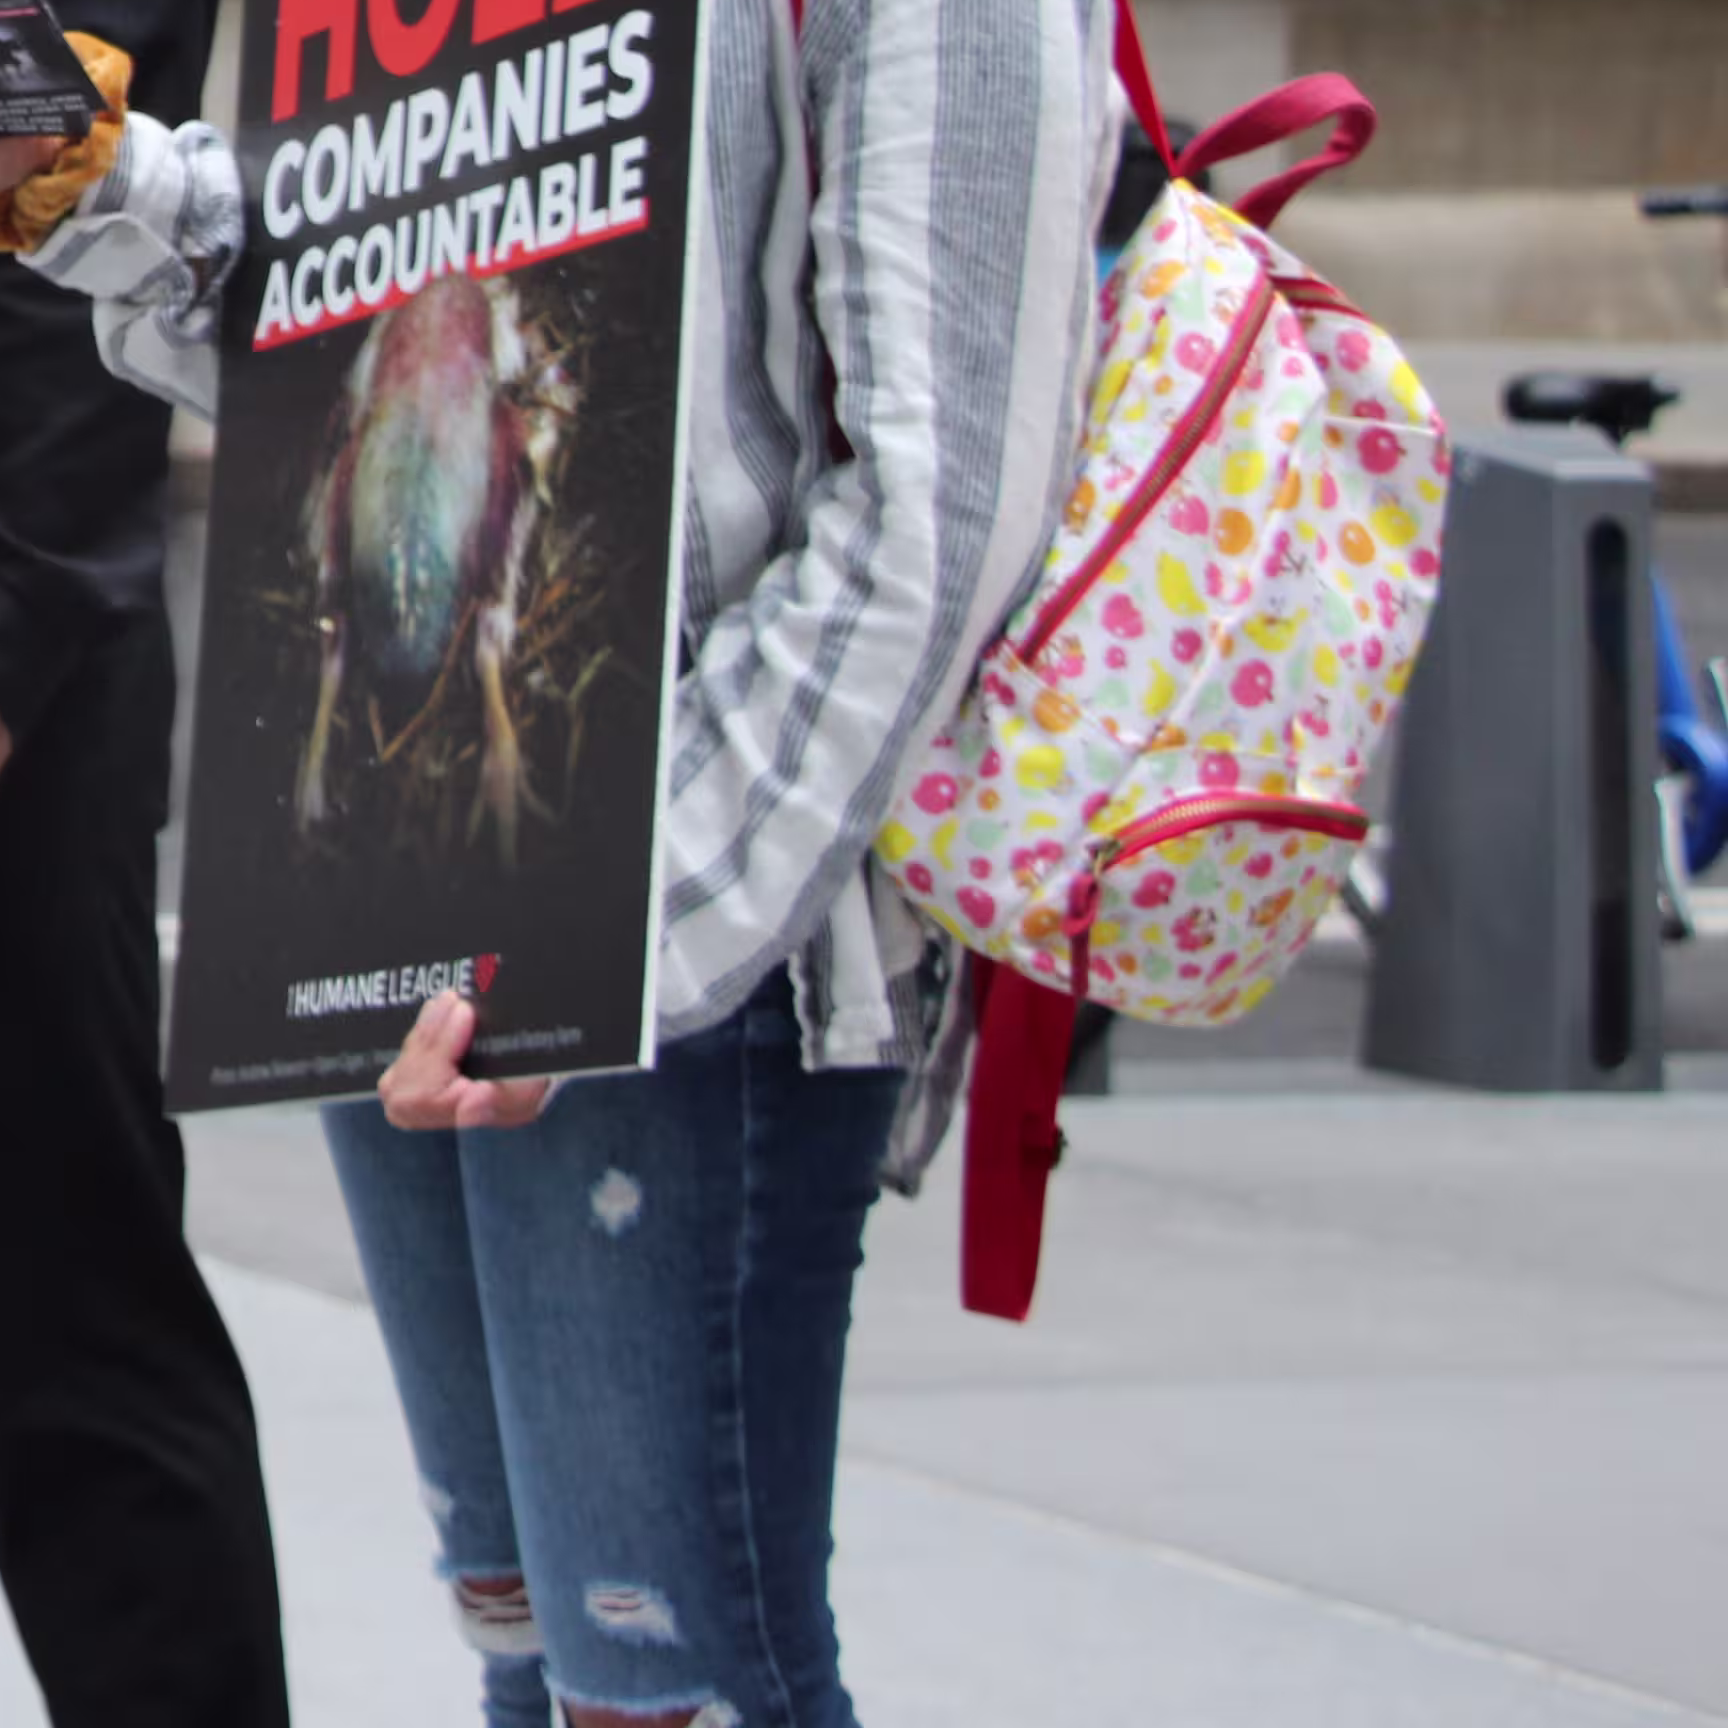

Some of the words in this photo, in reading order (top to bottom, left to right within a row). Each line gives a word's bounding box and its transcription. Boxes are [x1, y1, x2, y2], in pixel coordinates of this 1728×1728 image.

[263, 9, 653, 240] COMPANIES
[255, 136, 648, 341] ACCOUNTABLE
[294, 970, 388, 1018] HUMANE
[389, 957, 473, 1005] LEAGUE
